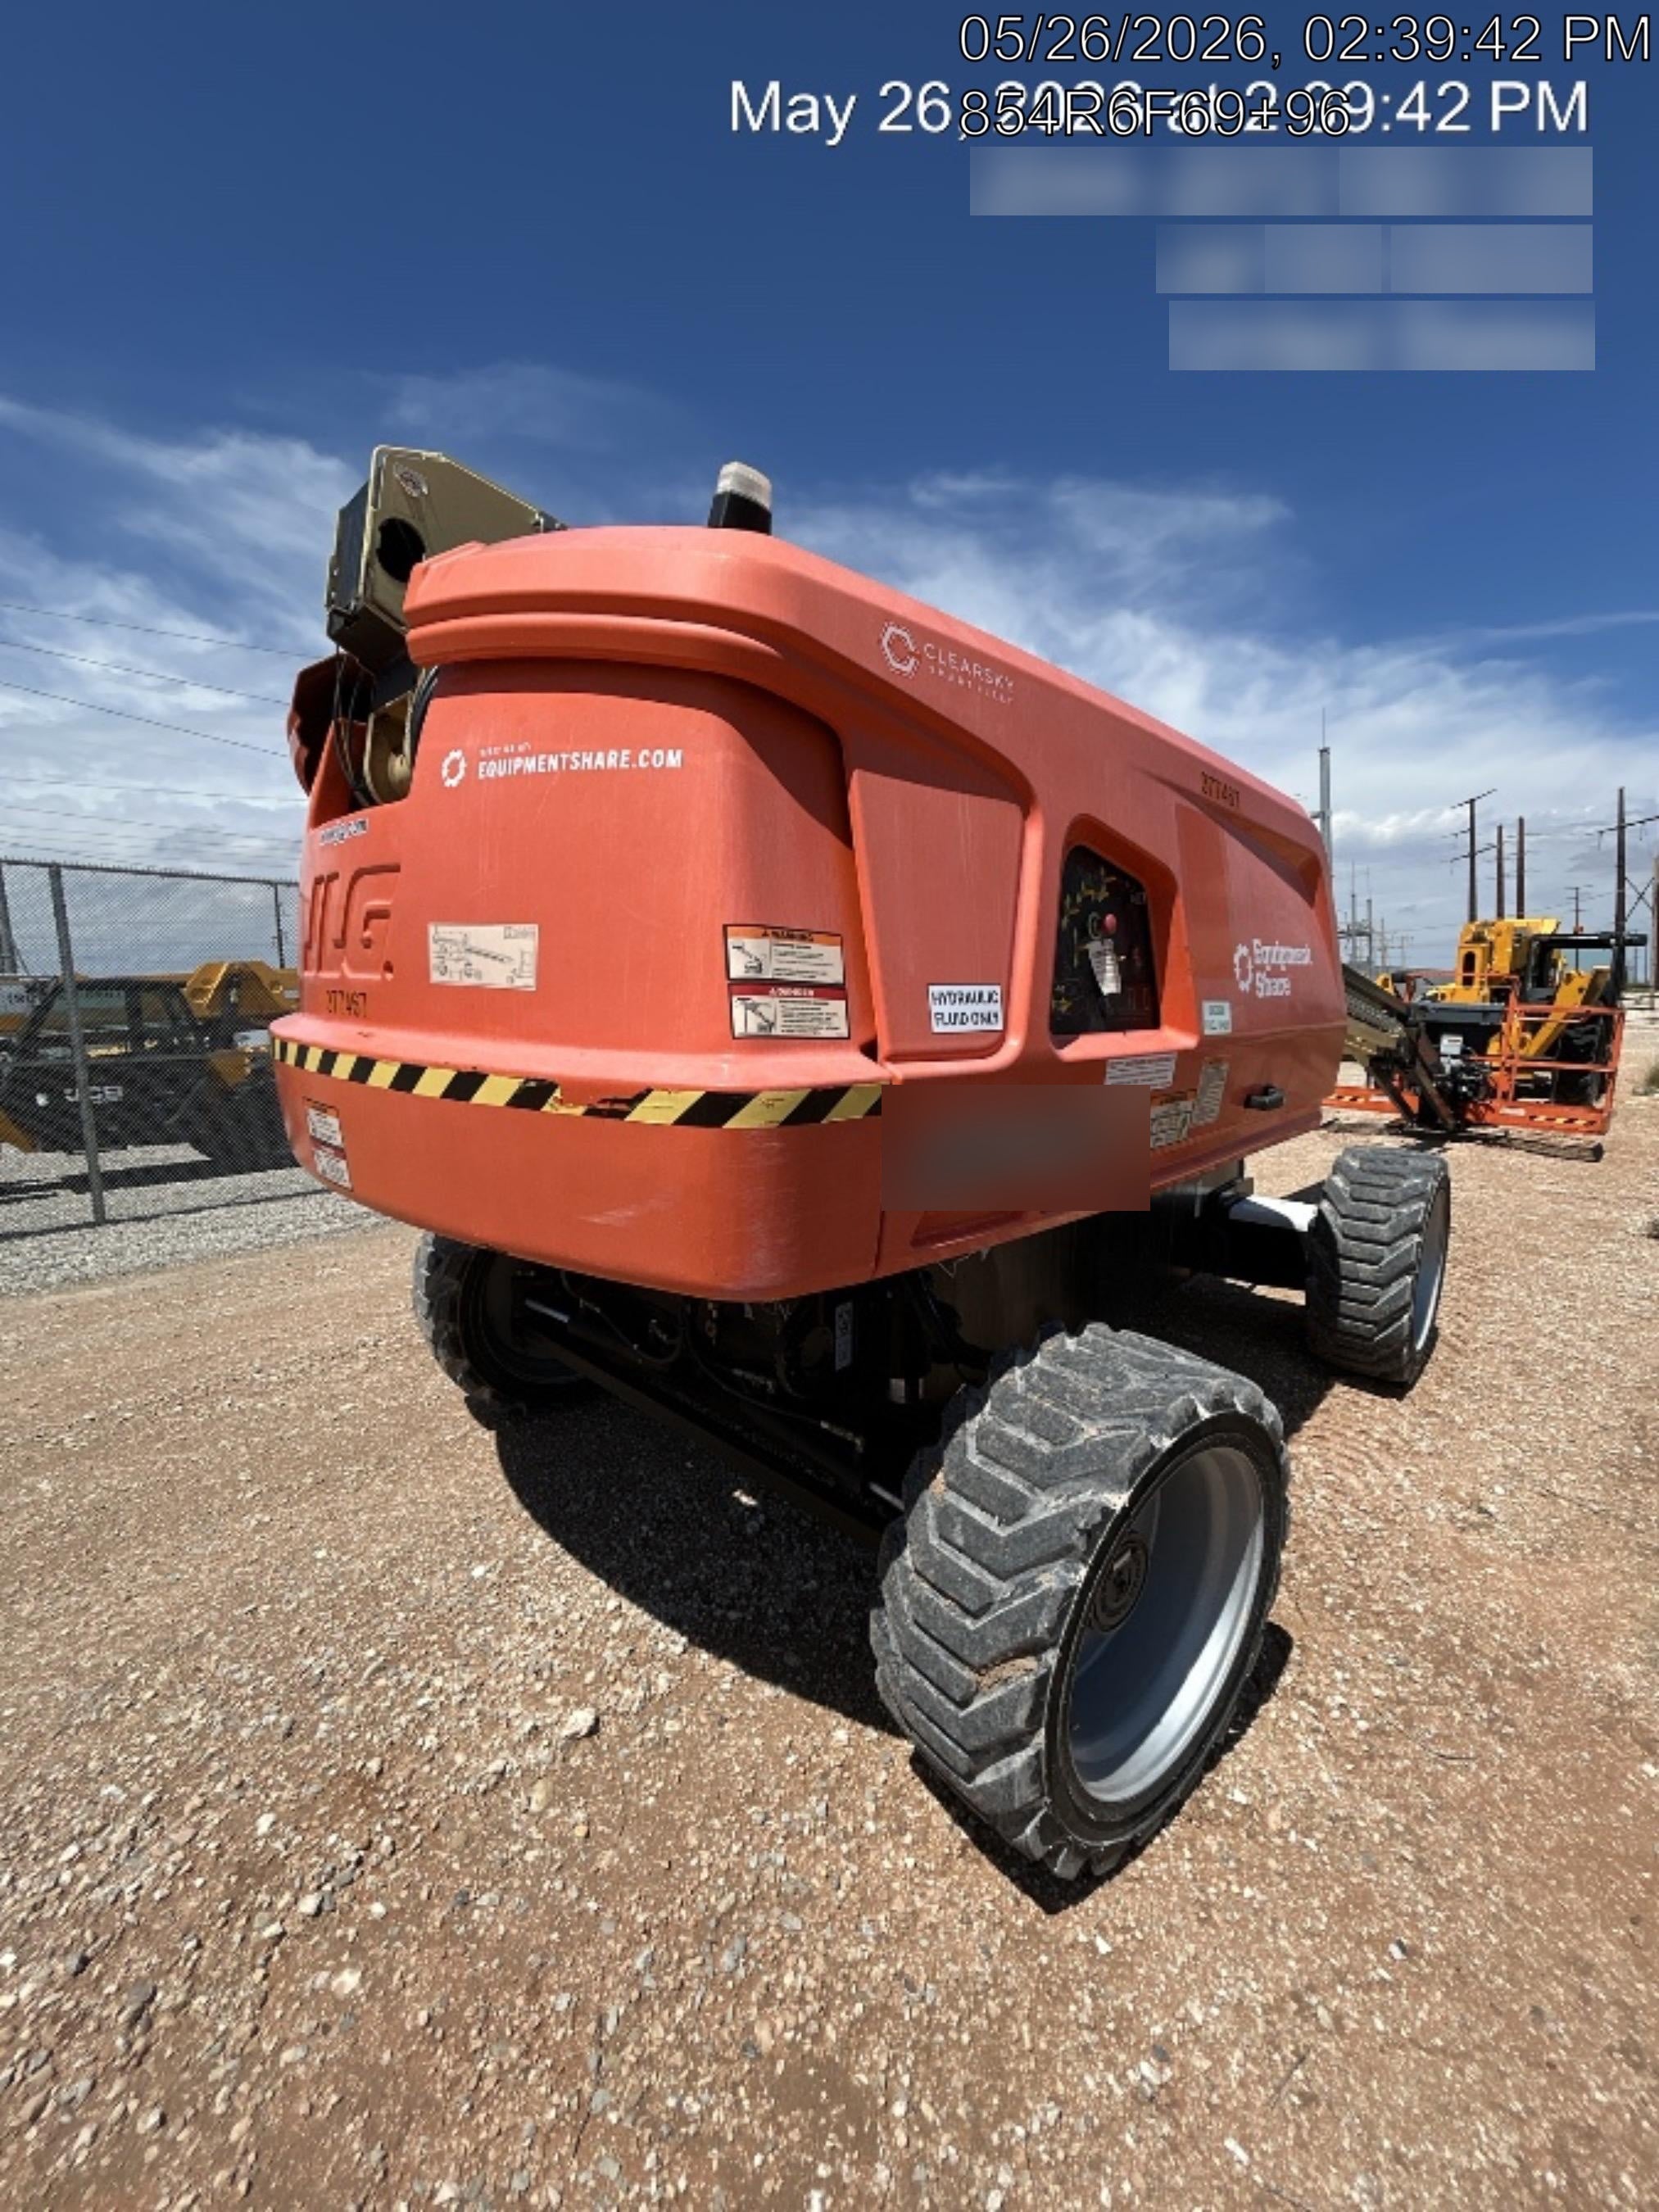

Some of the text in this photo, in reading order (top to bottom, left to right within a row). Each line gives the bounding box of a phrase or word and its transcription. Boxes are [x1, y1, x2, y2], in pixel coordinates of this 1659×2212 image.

[923, 643, 1014, 692] CLEARSKY
[478, 749, 684, 780] EQUIPMENTSHARE.COM
[931, 989, 999, 1005] HYDRAULIC
[934, 1010, 999, 1028] FLUID ONLY
